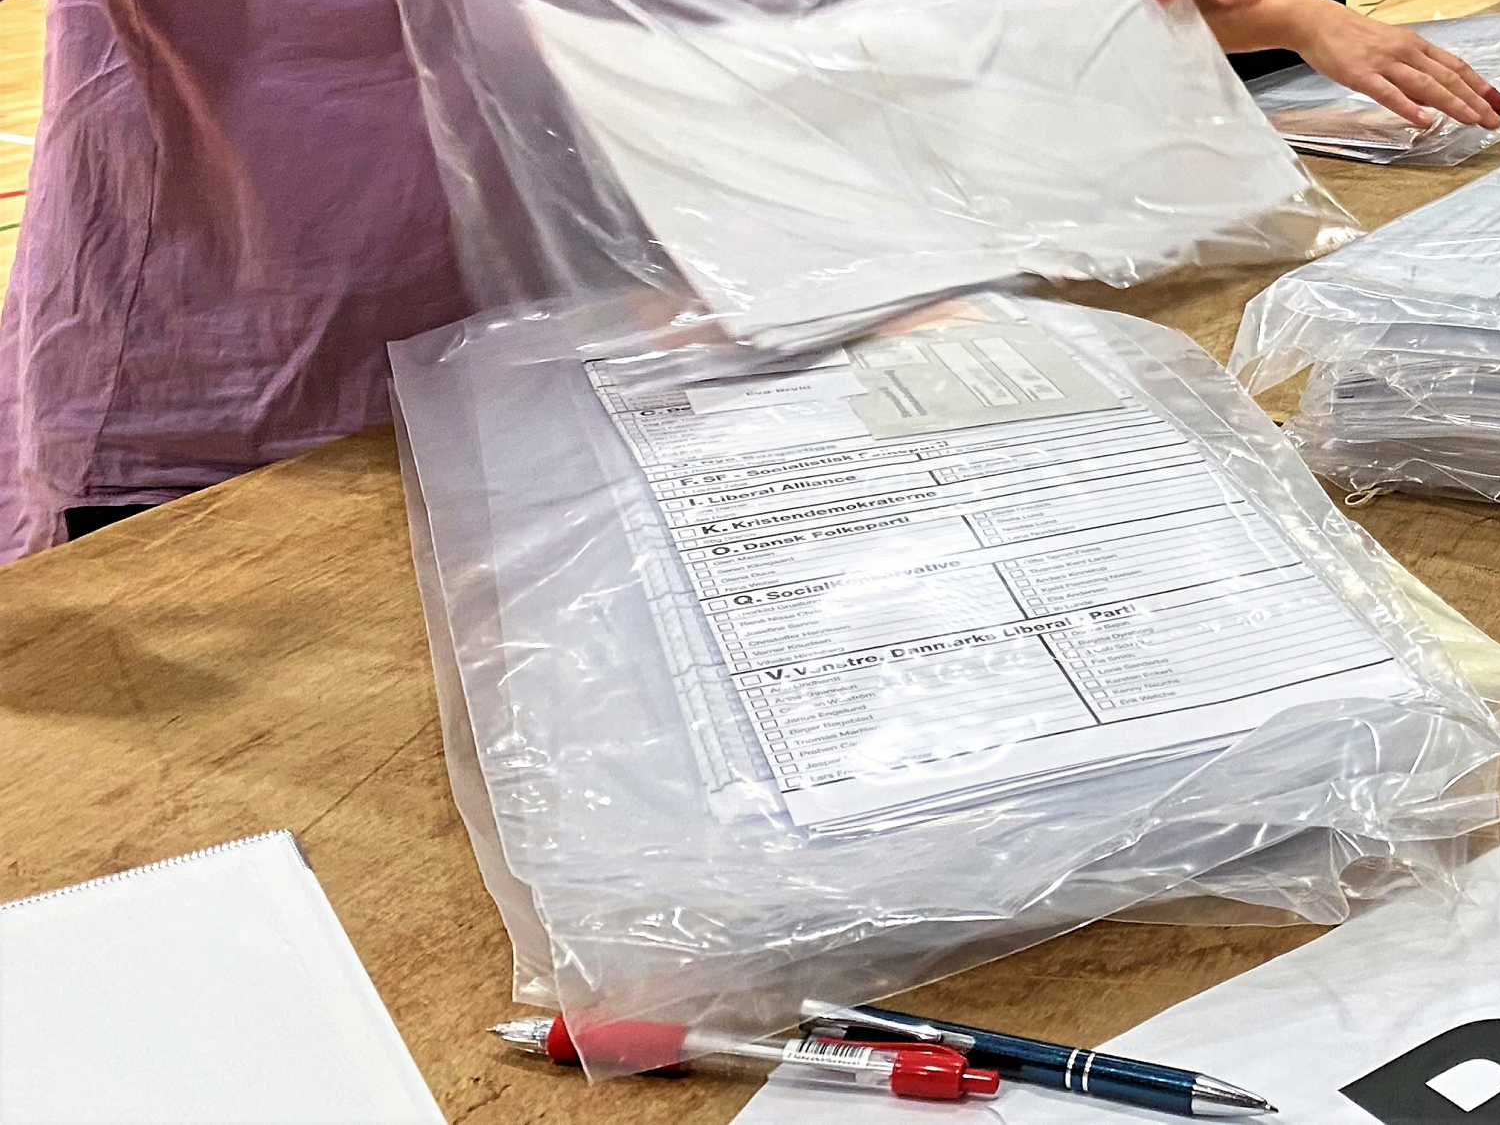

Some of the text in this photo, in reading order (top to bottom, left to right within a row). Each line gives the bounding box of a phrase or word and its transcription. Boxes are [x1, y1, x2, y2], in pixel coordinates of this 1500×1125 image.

[679, 476, 699, 486] F.
[702, 473, 728, 483] SF
[745, 453, 853, 477] Socialistisk
[688, 472, 857, 506] I. Liberal Alliance
[700, 522, 728, 535] K.
[731, 486, 938, 532] Kristendemokraterne
[709, 515, 911, 556] O. Dansk Folkeparti
[731, 592, 763, 607] Q.
[747, 632, 801, 647] Christoffer
[764, 668, 790, 681] V.
[890, 633, 997, 658] Danmarks
[1002, 616, 1085, 637] Liberal
[1088, 604, 1137, 620] Parti
